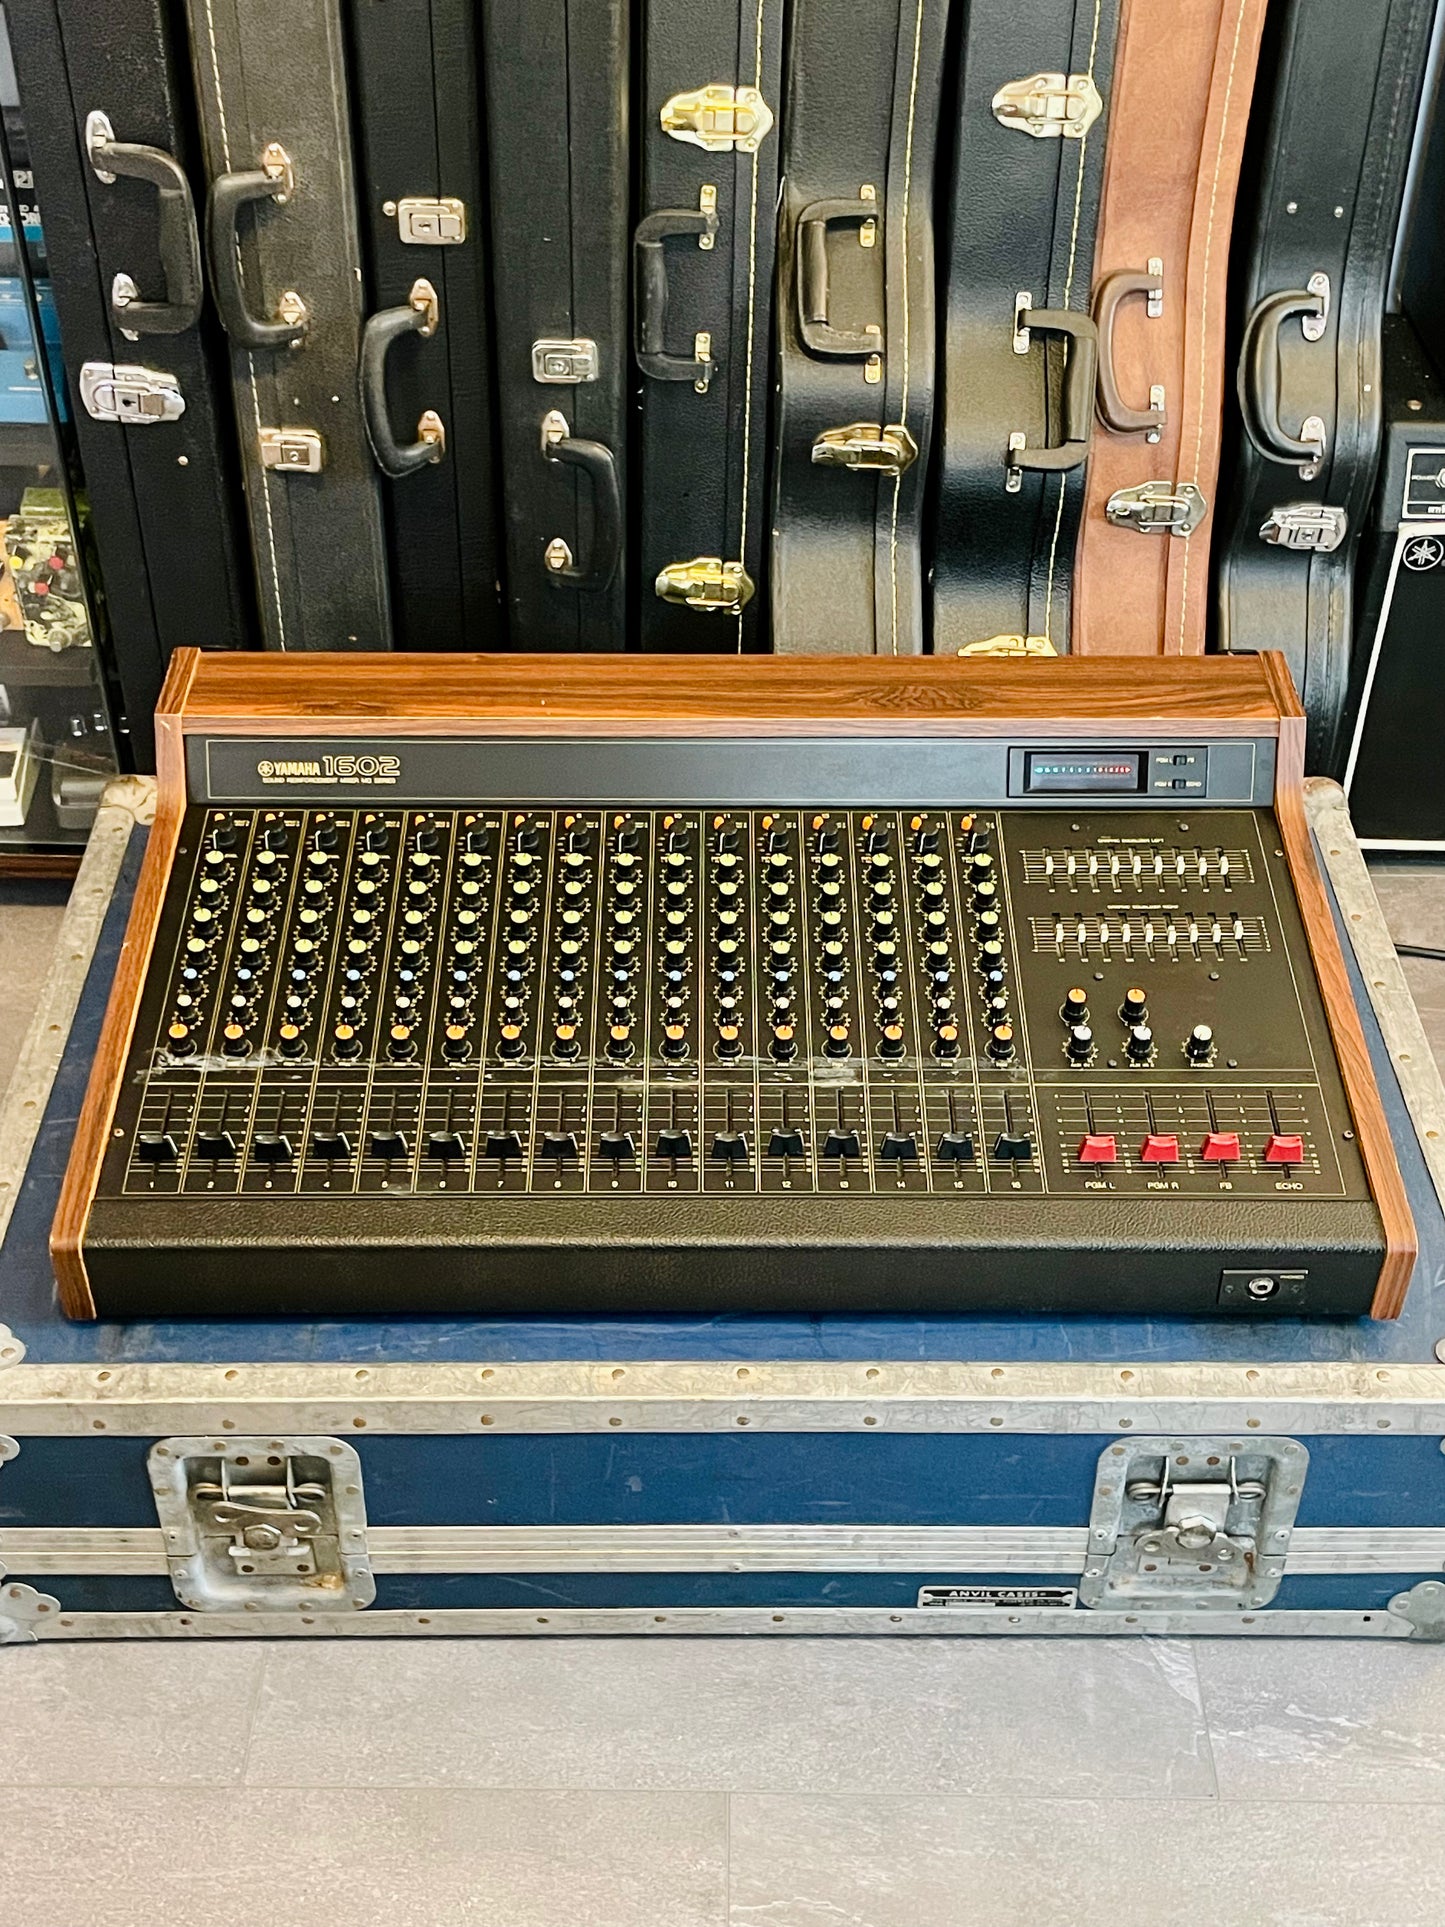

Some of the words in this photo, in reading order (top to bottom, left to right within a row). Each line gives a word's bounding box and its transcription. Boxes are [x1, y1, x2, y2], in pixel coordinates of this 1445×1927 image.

[273, 762, 321, 776] YAMAHA
[322, 755, 401, 777] 1602
[149, 1181, 155, 1189] 1
[497, 1181, 504, 1189] 7
[668, 1181, 678, 1189] 10
[725, 1181, 734, 1189] 11
[782, 1181, 792, 1189] 12
[1085, 1182, 1106, 1190] PGM
[1109, 1182, 1116, 1190] L
[1147, 1182, 1169, 1190] PGM
[1171, 1182, 1180, 1190] R
[1219, 1182, 1233, 1190] FB
[1275, 1182, 1304, 1190] ECHO
[949, 1590, 993, 1598] ANVIL
